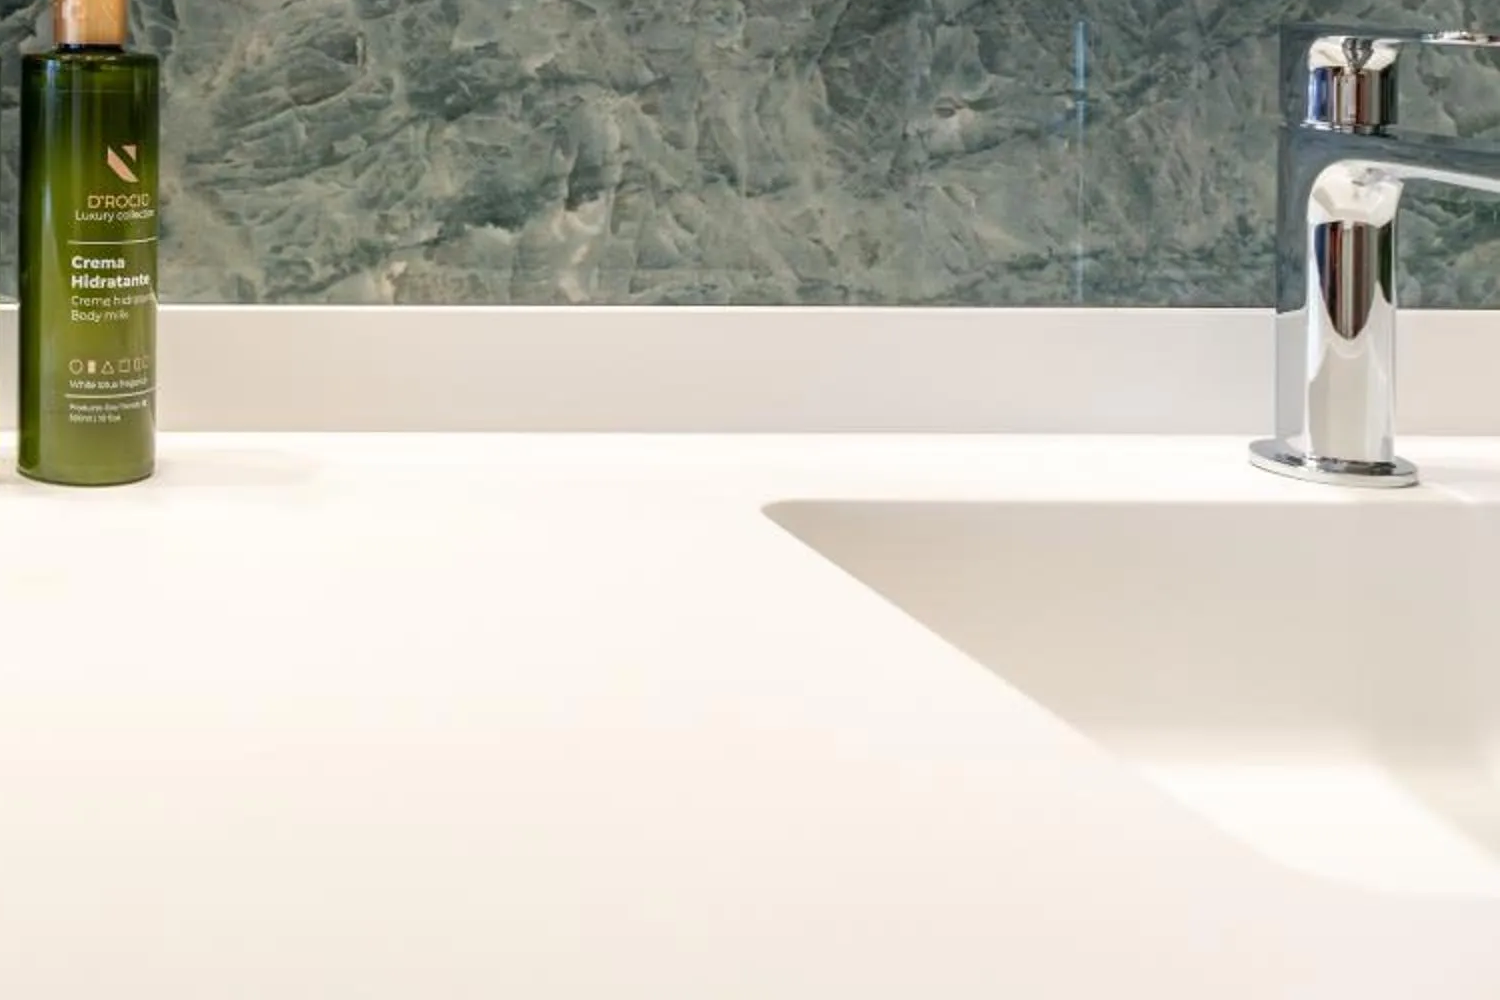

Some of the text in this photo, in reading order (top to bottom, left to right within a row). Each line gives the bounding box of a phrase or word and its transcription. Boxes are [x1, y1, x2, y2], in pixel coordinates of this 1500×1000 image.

[75, 210, 114, 223] Luxury
[71, 255, 126, 270] Crema
[71, 309, 101, 323] Body
